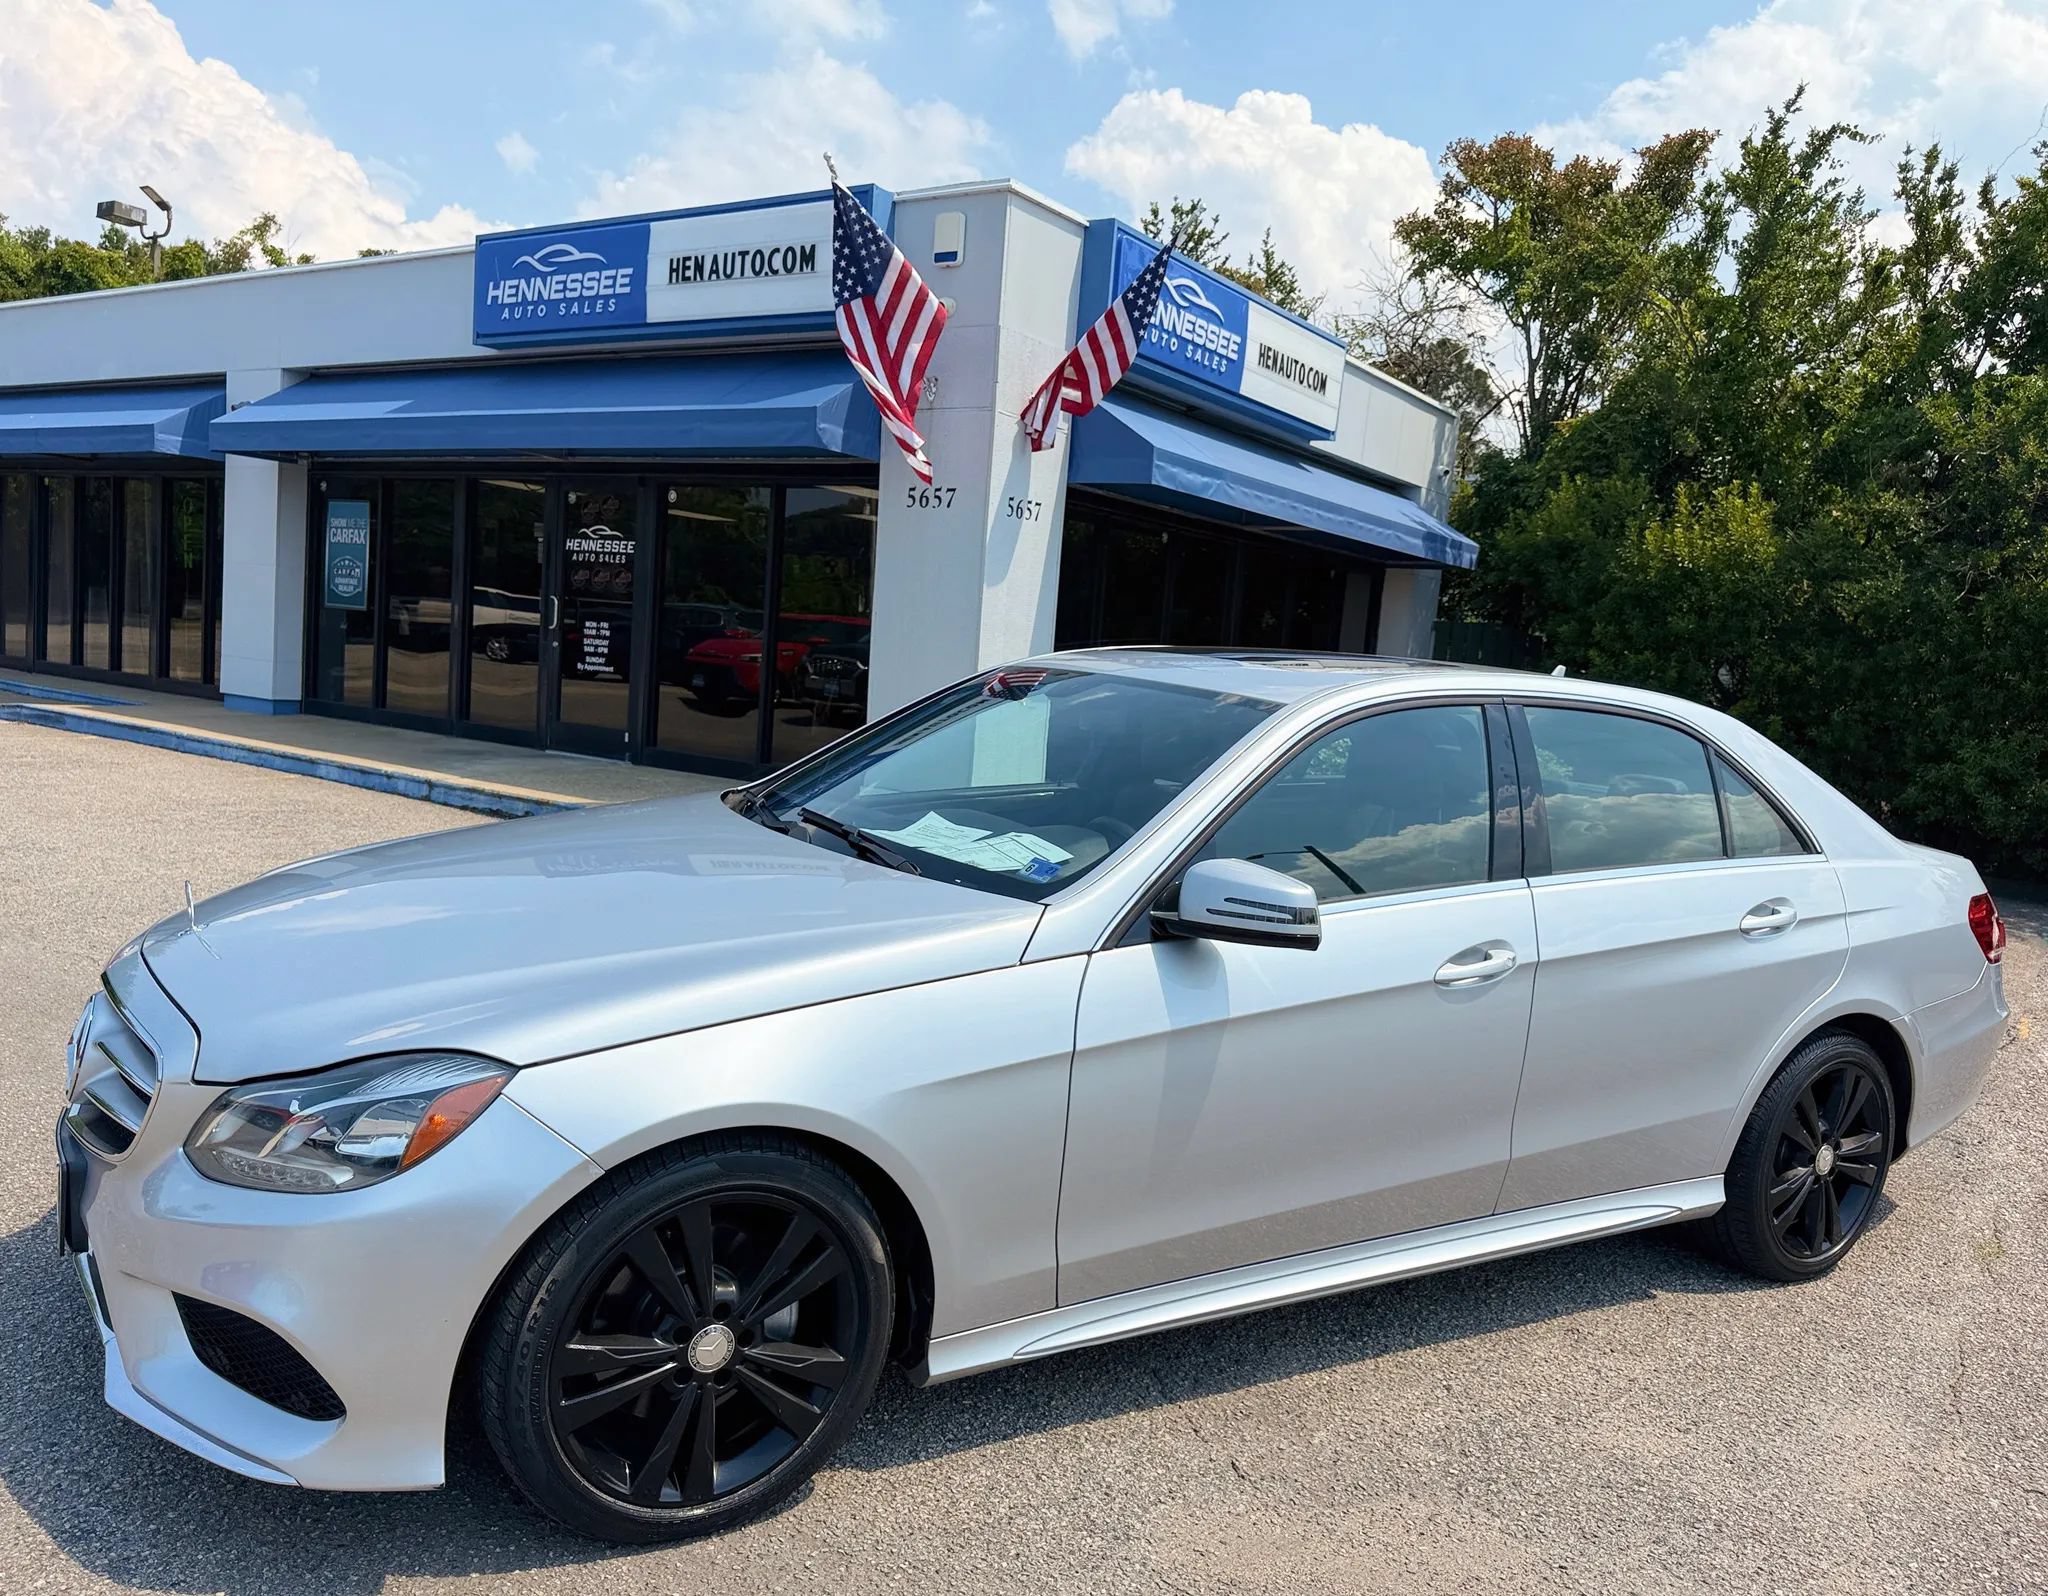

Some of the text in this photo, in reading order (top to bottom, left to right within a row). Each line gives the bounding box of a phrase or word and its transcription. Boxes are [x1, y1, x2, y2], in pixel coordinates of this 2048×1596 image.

[668, 244, 817, 284] HENAUTO.COM
[486, 267, 634, 306] HENNESSEE
[500, 298, 617, 321] AUTO SALES
[1150, 301, 1241, 361] NNESSEE
[1186, 343, 1228, 373] SALES
[906, 486, 957, 509] 5657
[1006, 496, 1042, 522] 5657
[330, 518, 347, 528] SHOW
[330, 527, 366, 545] CARFAX
[565, 538, 636, 553] HENNESSEE
[572, 552, 627, 563] AUTO SALES
[600, 621, 609, 629] FRI
[583, 637, 609, 647] SATURDAY
[577, 662, 614, 672] By Appointment
[585, 655, 606, 664] SUNDAY
